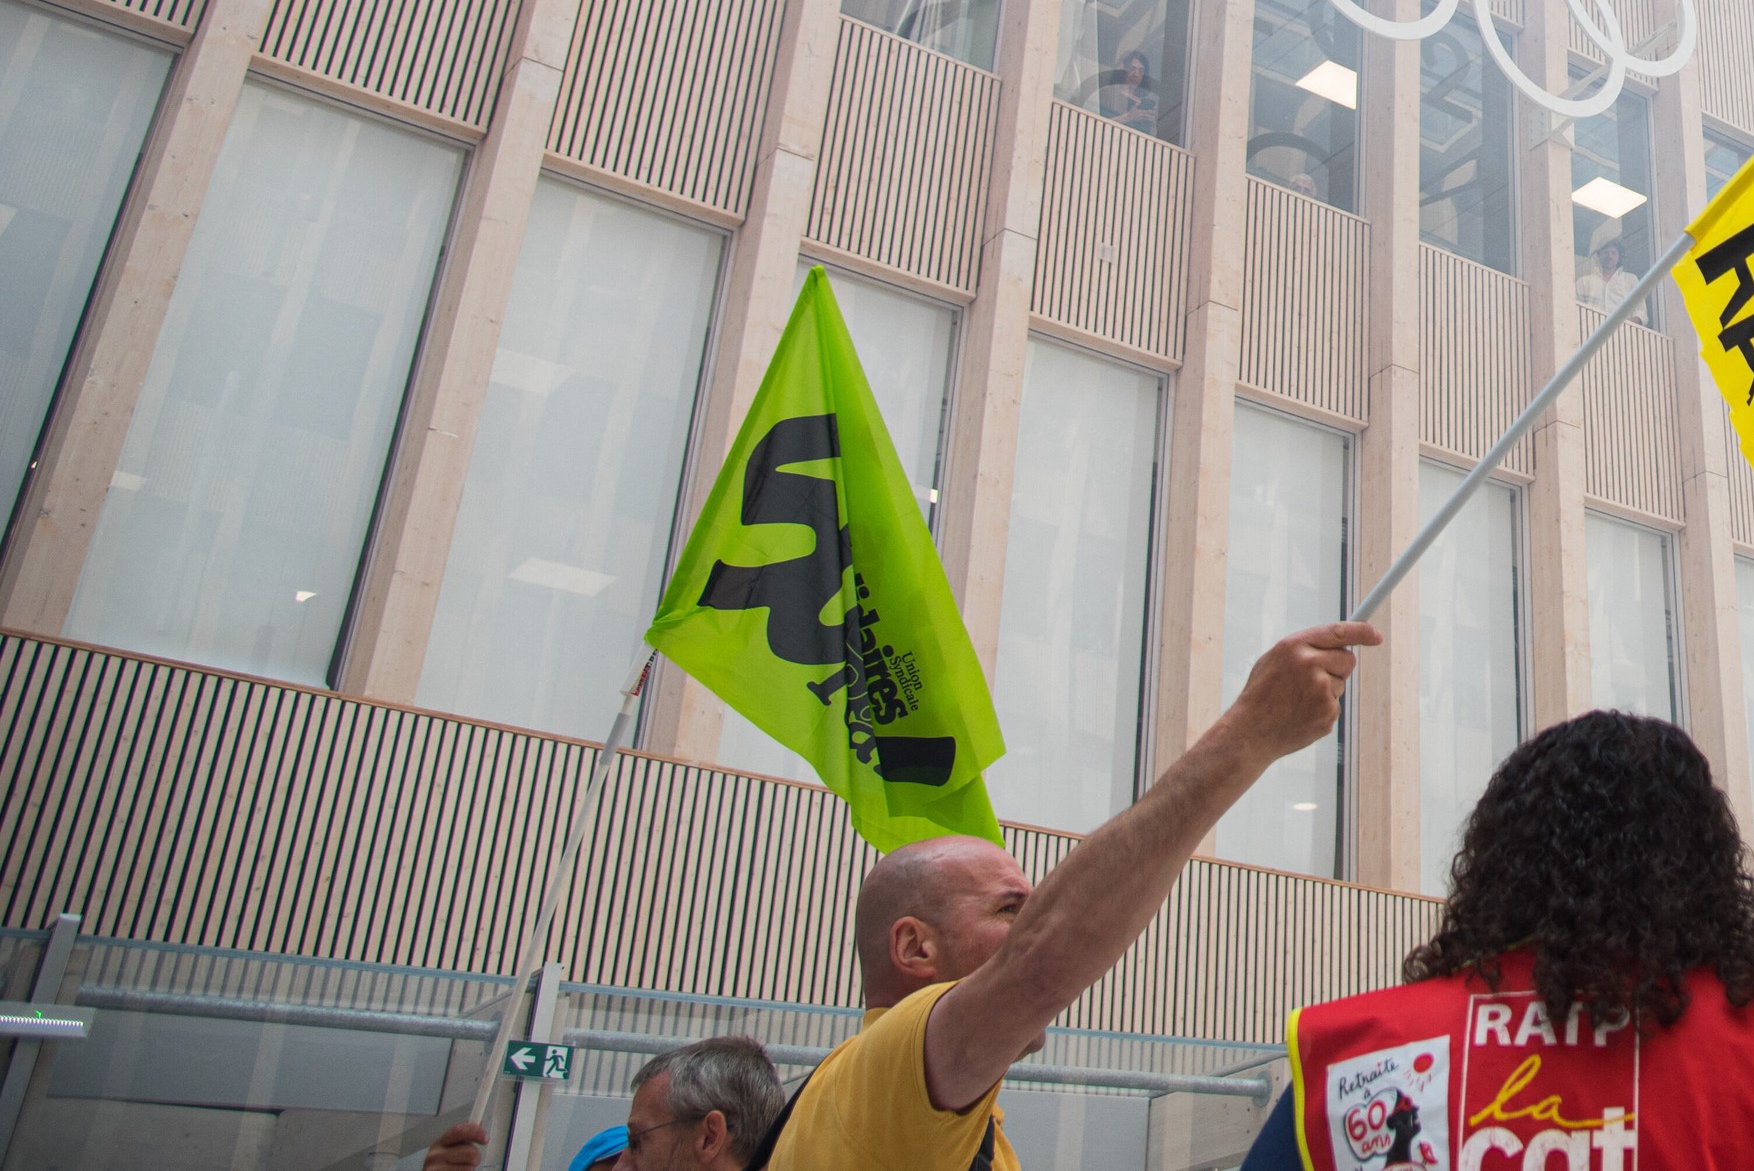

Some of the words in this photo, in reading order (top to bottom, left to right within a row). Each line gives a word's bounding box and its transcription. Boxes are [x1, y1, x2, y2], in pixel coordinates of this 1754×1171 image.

[889, 655, 919, 712] Syndicale
[901, 650, 923, 691] Union
[1338, 1056, 1400, 1101] Retraite
[1468, 1053, 1636, 1128] la
[1346, 1098, 1387, 1142] 60
[1361, 1132, 1392, 1154] ans
